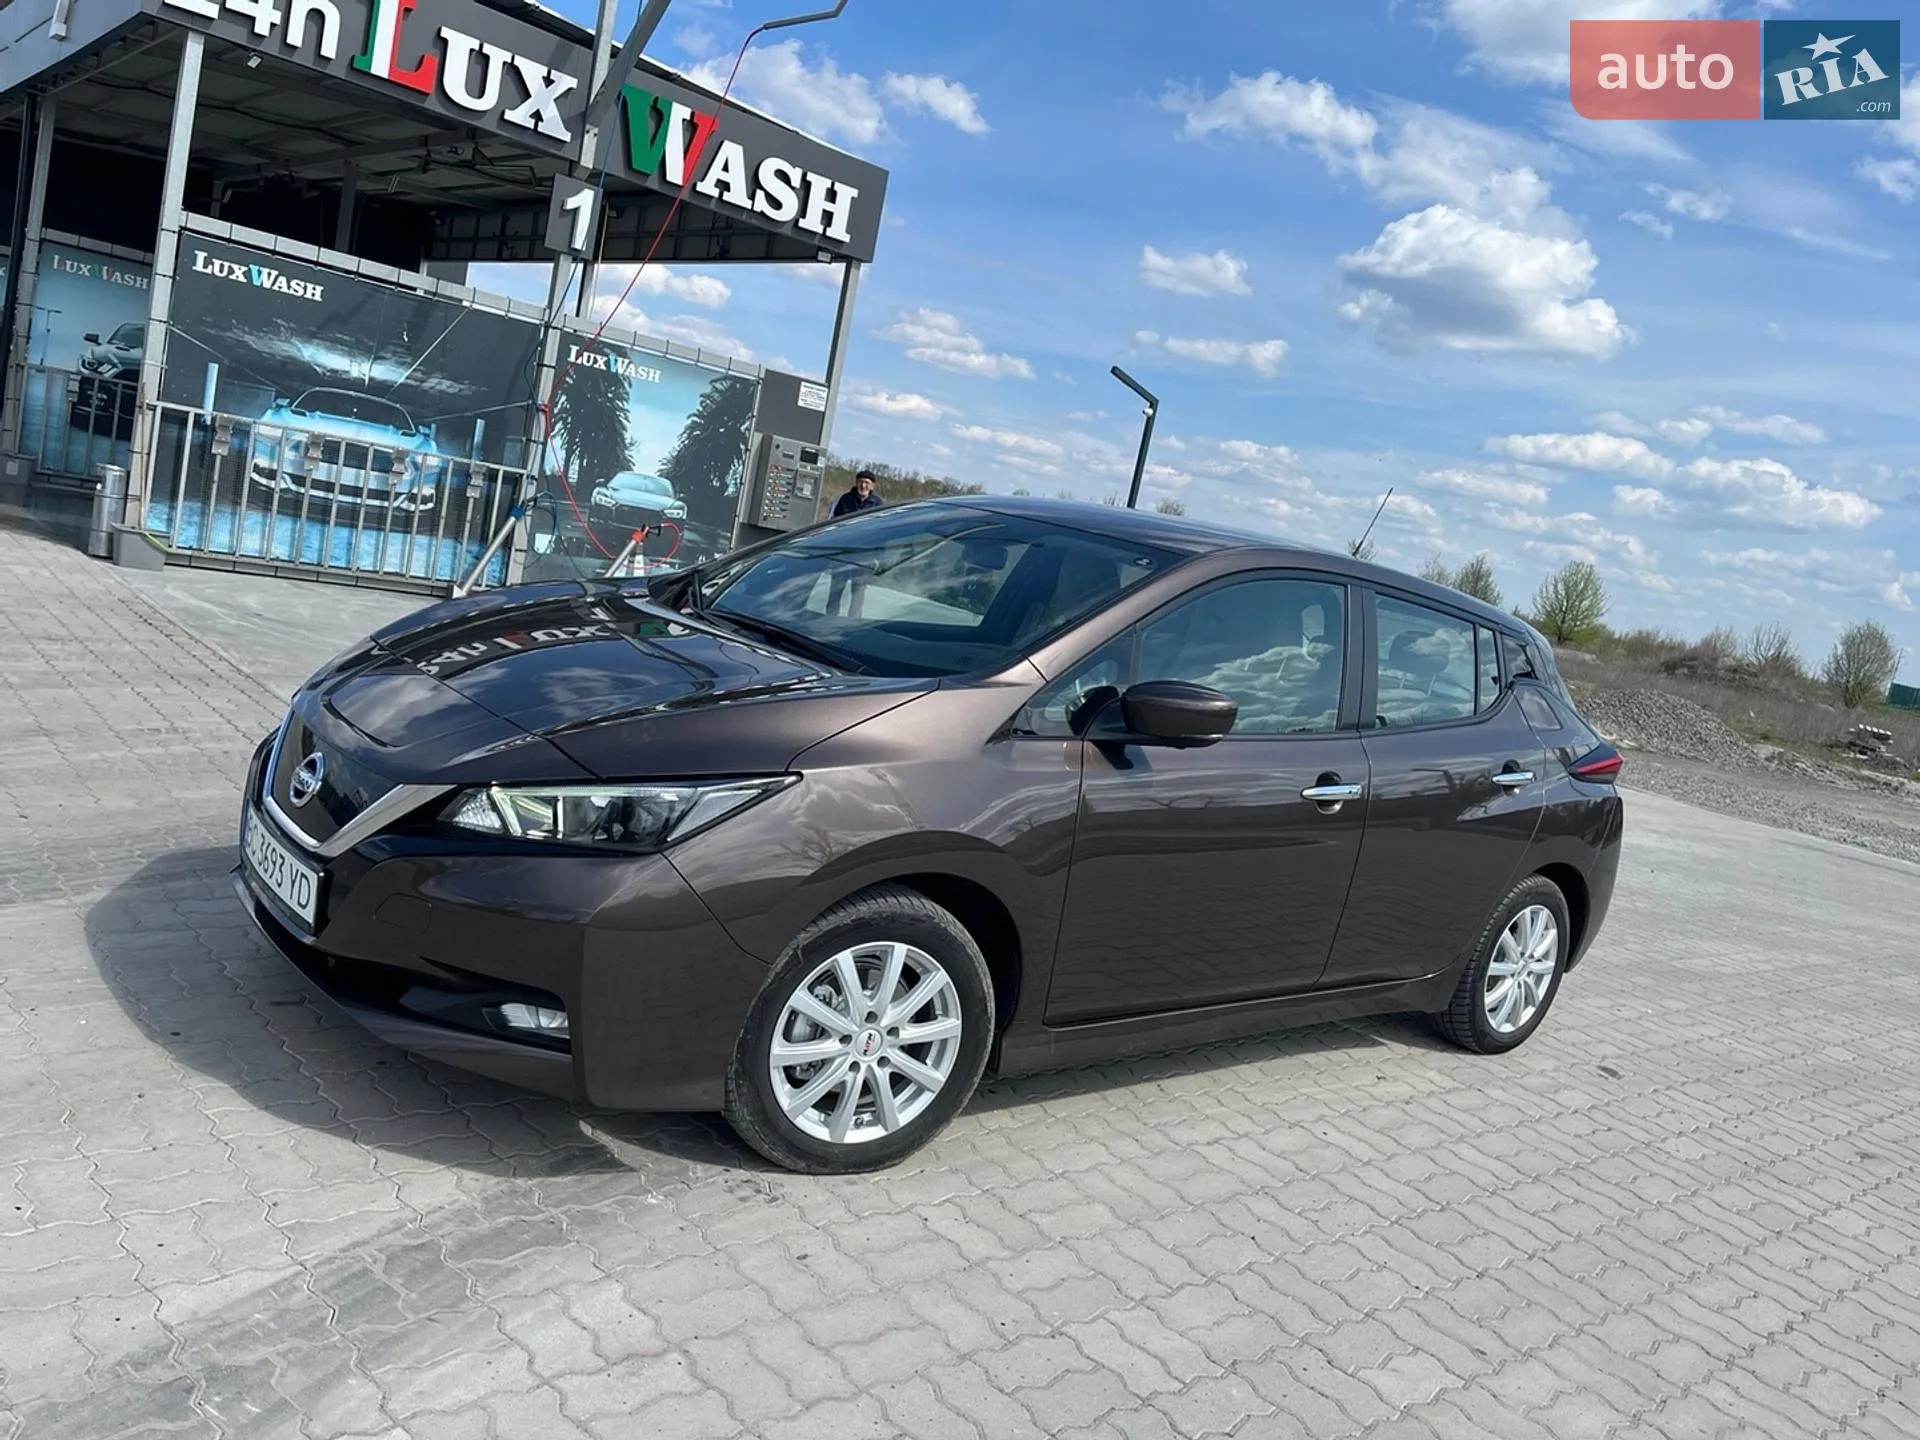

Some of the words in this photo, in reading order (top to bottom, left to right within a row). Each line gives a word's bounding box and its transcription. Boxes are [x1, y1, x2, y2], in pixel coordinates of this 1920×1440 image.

[352, 0, 579, 143] LUX
[620, 82, 859, 244] WASH
[563, 187, 596, 251] 1
[258, 832, 286, 889] 3693
[289, 862, 311, 910] YD
